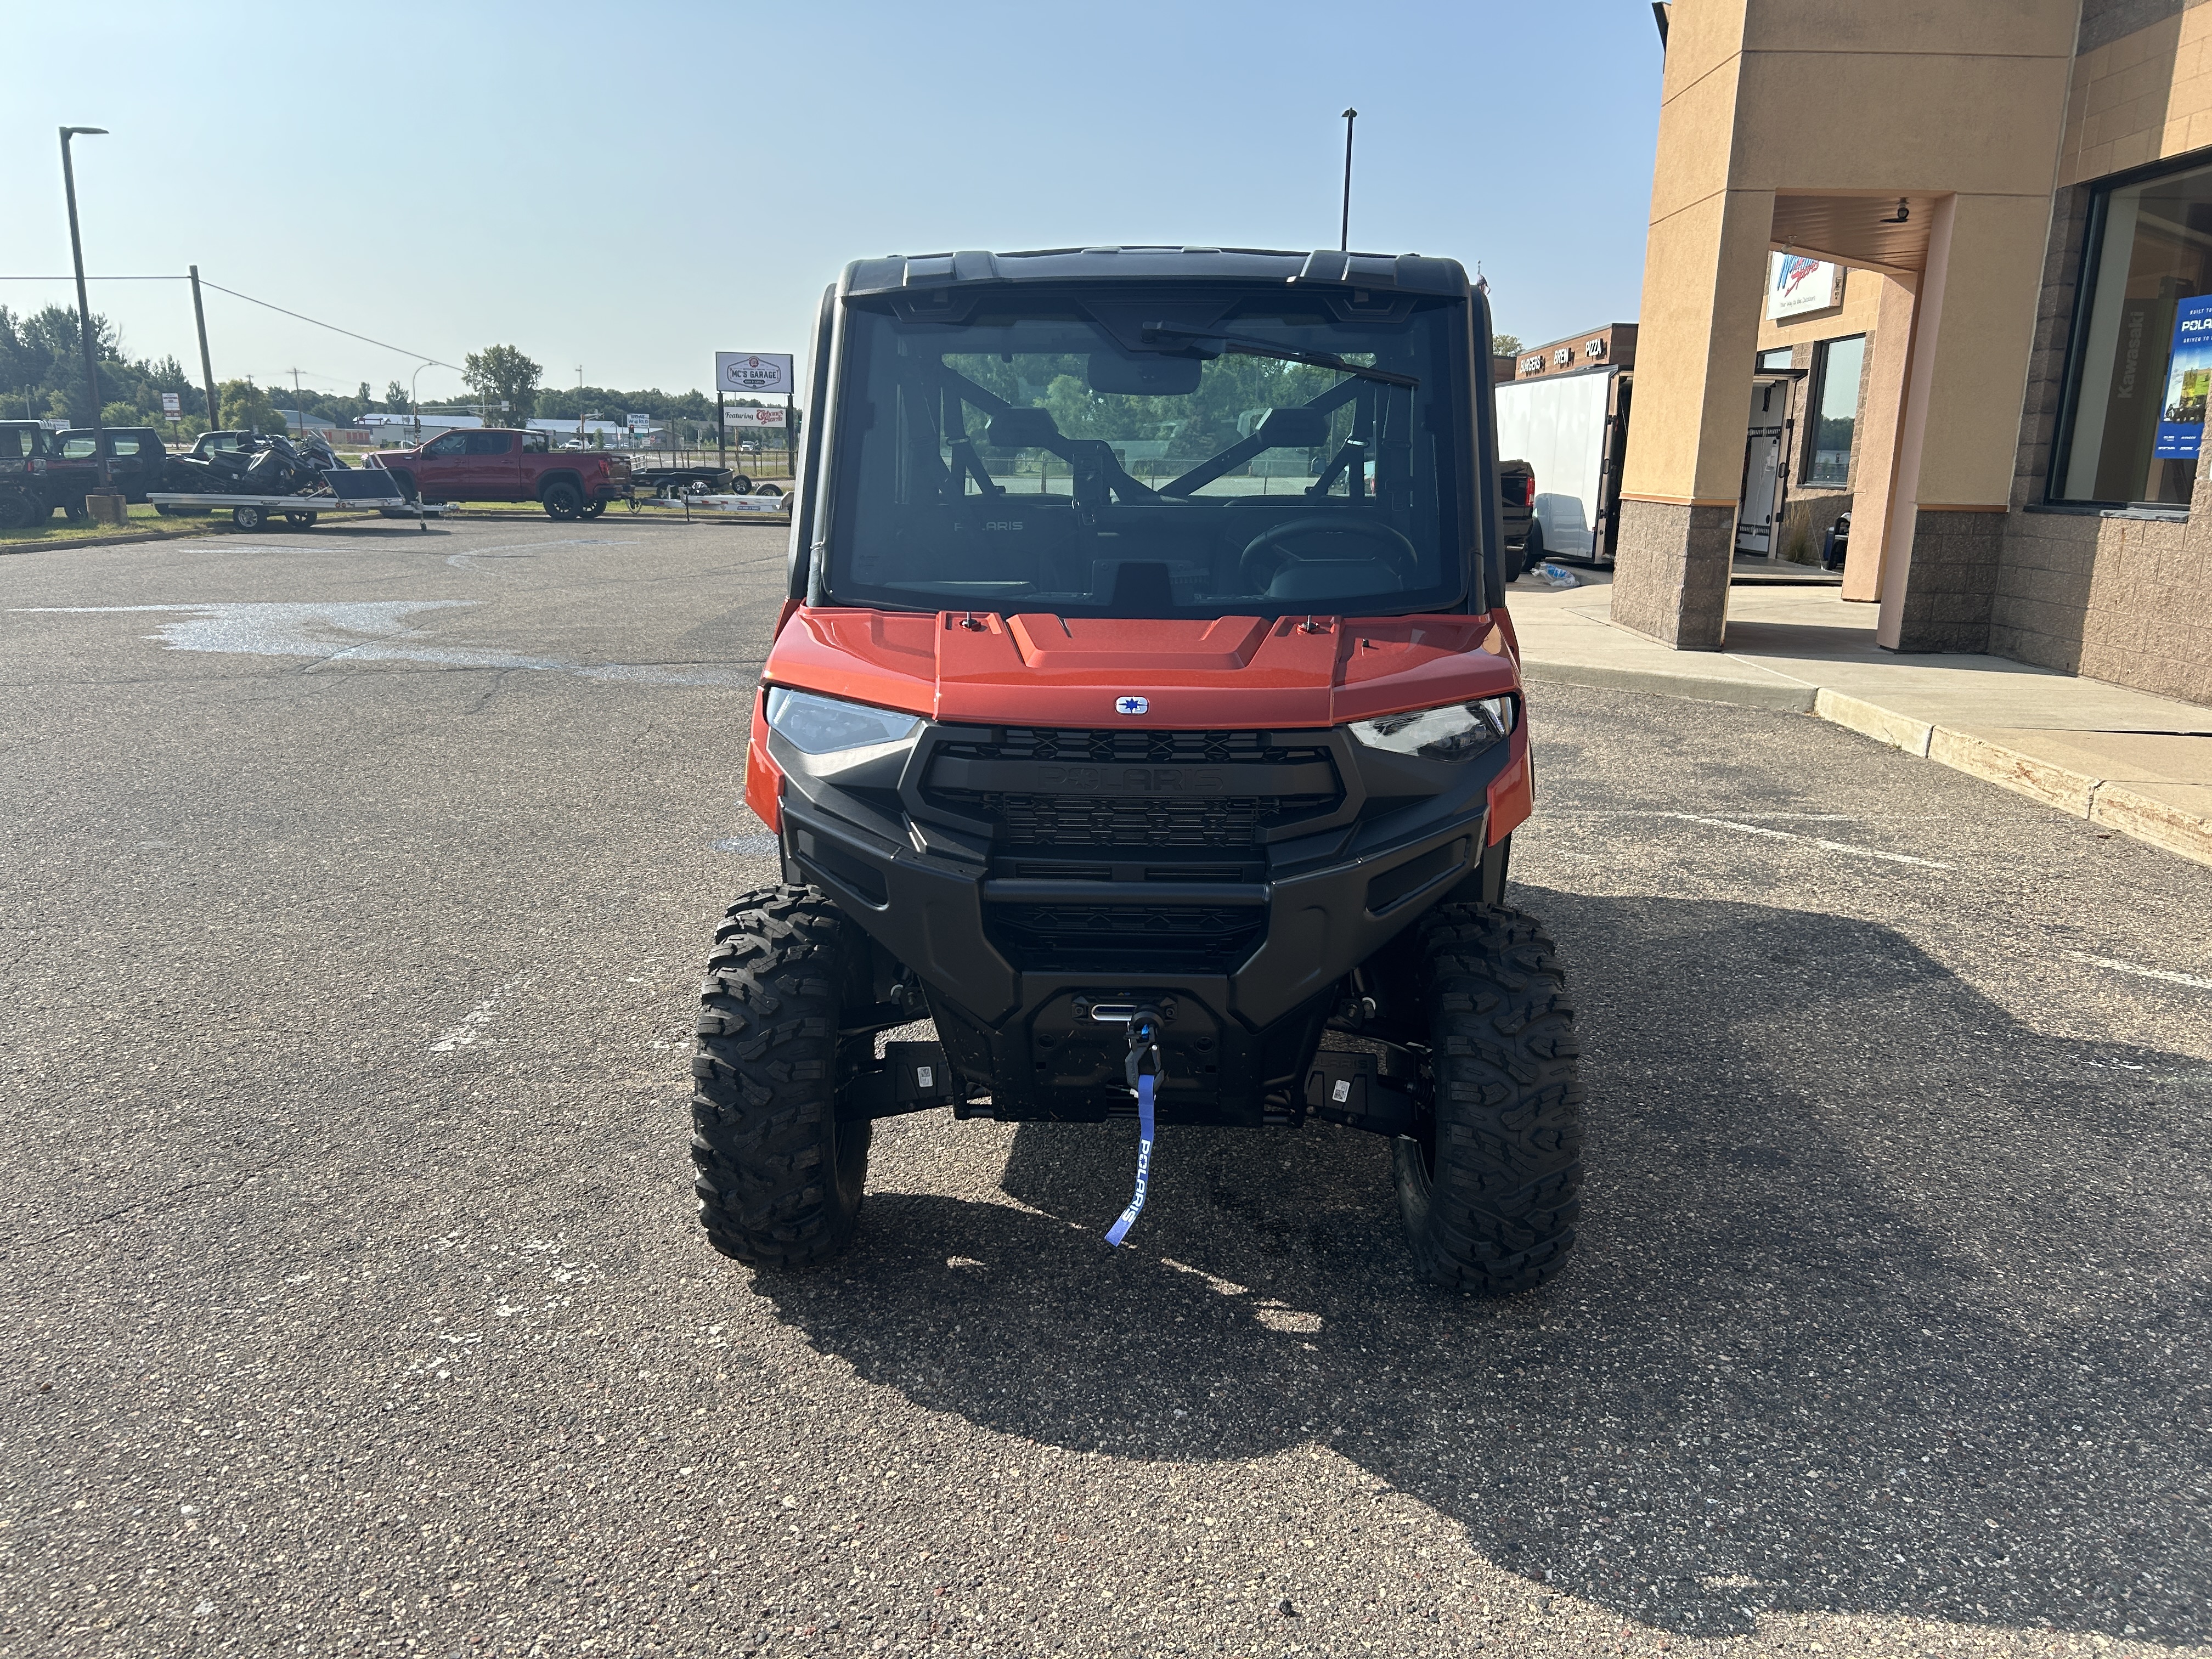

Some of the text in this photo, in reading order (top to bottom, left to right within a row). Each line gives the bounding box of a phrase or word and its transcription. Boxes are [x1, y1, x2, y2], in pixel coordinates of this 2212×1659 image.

[2181, 318, 2212, 332] POLA
[1520, 338, 1602, 373] BURGERS BREW PIZZA
[2118, 312, 2145, 399] Kawasaki
[732, 370, 777, 379] MC'S GARAGE
[725, 411, 754, 421] Featuring
[1038, 766, 1223, 791] POLARIS
[1121, 1138, 1151, 1223] POLARIS
